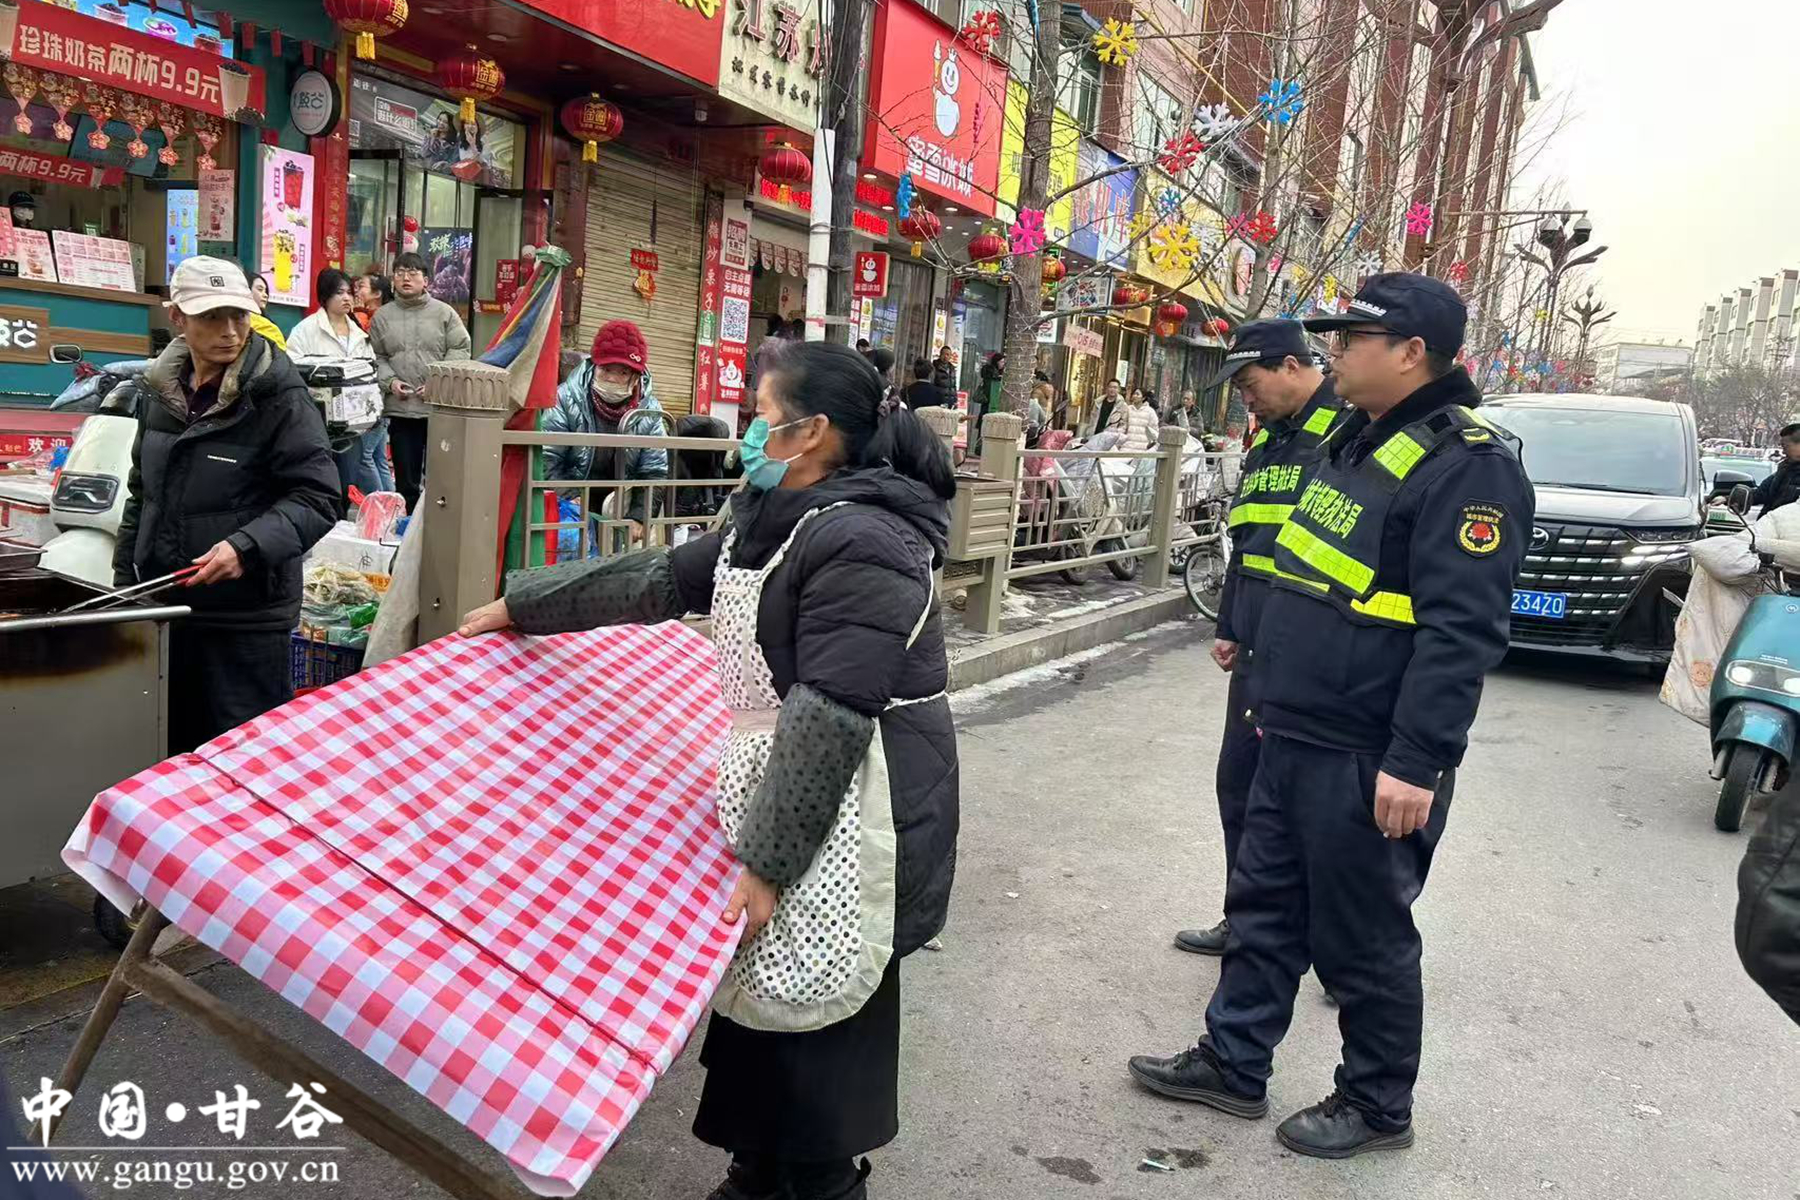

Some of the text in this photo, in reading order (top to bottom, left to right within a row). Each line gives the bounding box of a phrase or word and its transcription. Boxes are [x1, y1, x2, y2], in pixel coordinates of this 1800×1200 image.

[18, 23, 220, 104] 珍珠奶茶两杯9.9元
[906, 135, 973, 198] 蜜雪冰城
